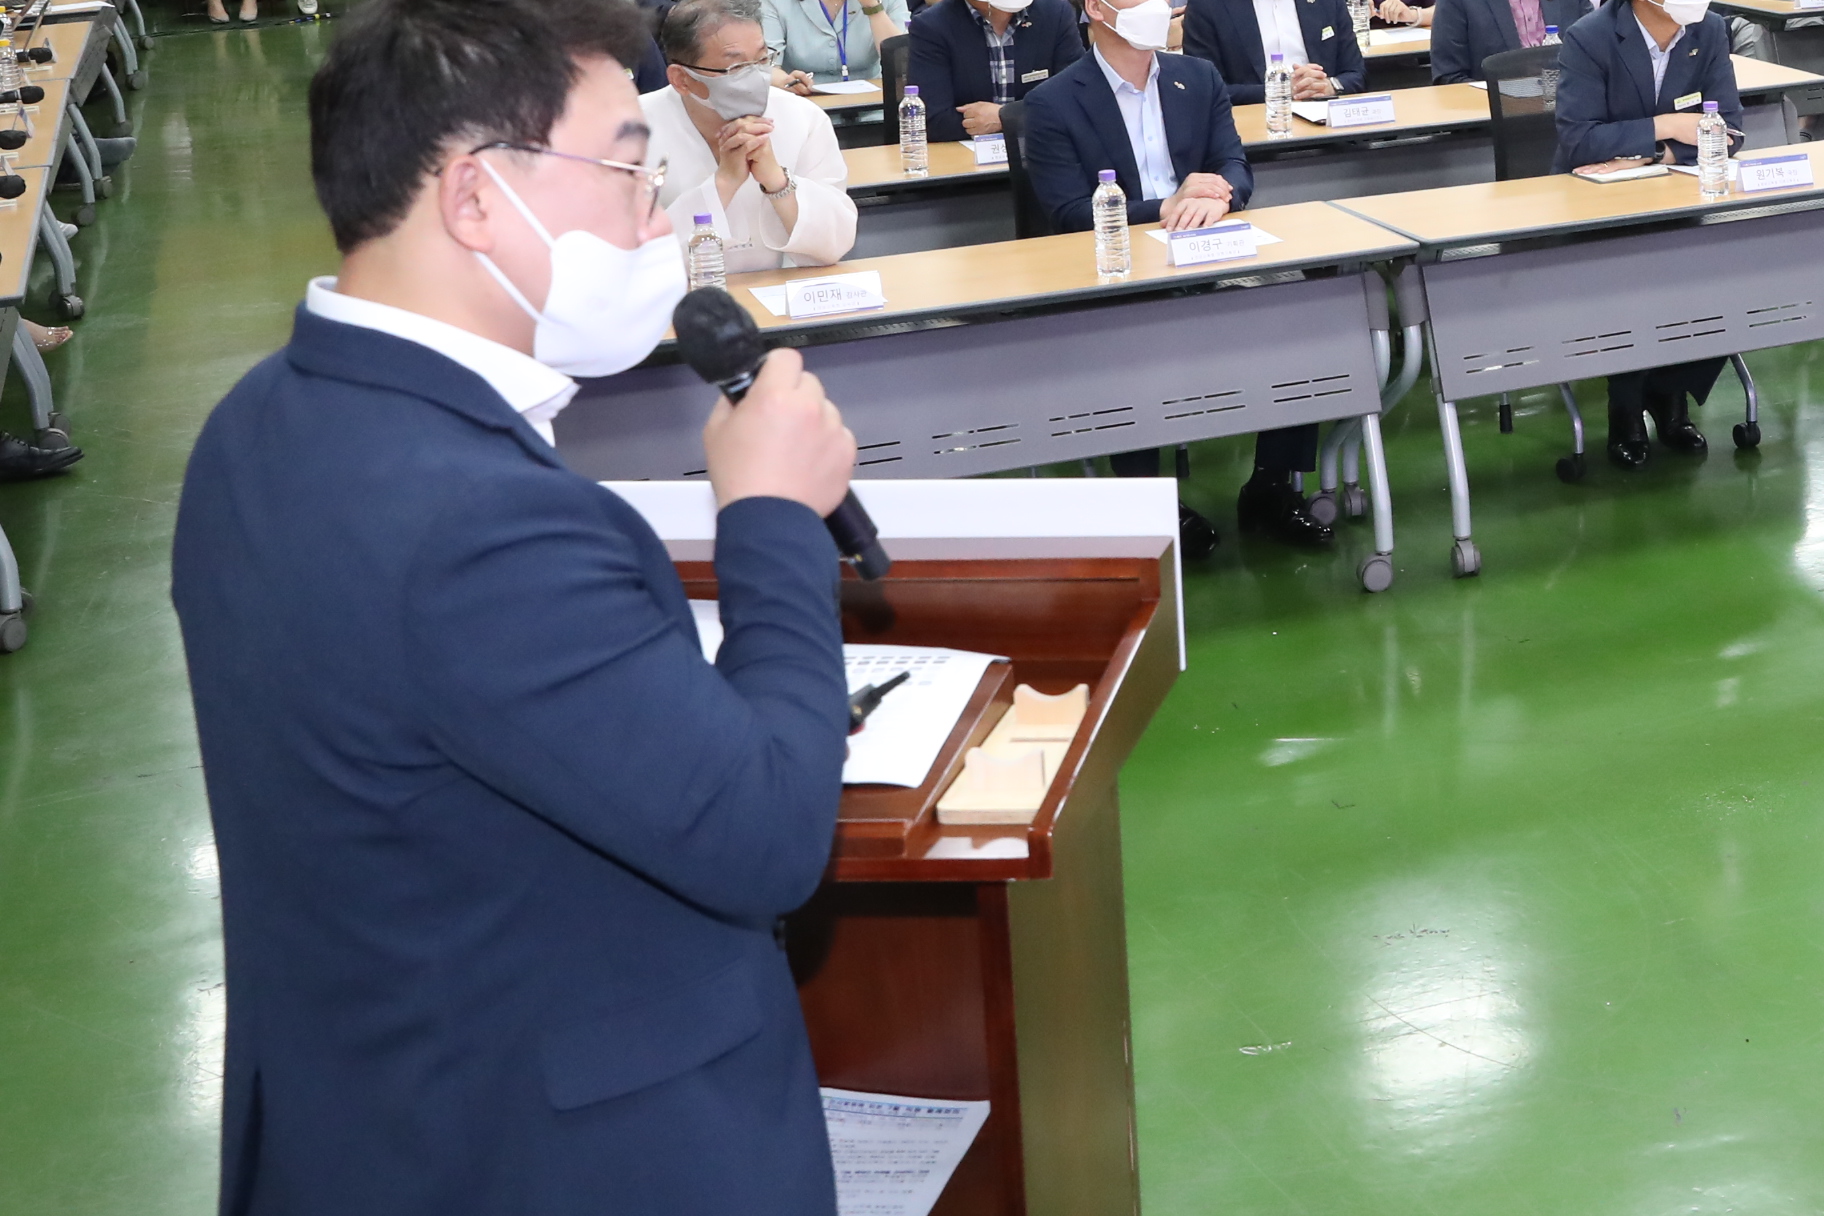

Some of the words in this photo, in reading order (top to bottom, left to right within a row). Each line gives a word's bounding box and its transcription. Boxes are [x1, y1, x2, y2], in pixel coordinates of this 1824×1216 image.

[1343, 107, 1369, 117] 김태균
[1756, 167, 1784, 180] 원기복
[1189, 238, 1222, 252] 이경구
[803, 288, 842, 304] 이민재
